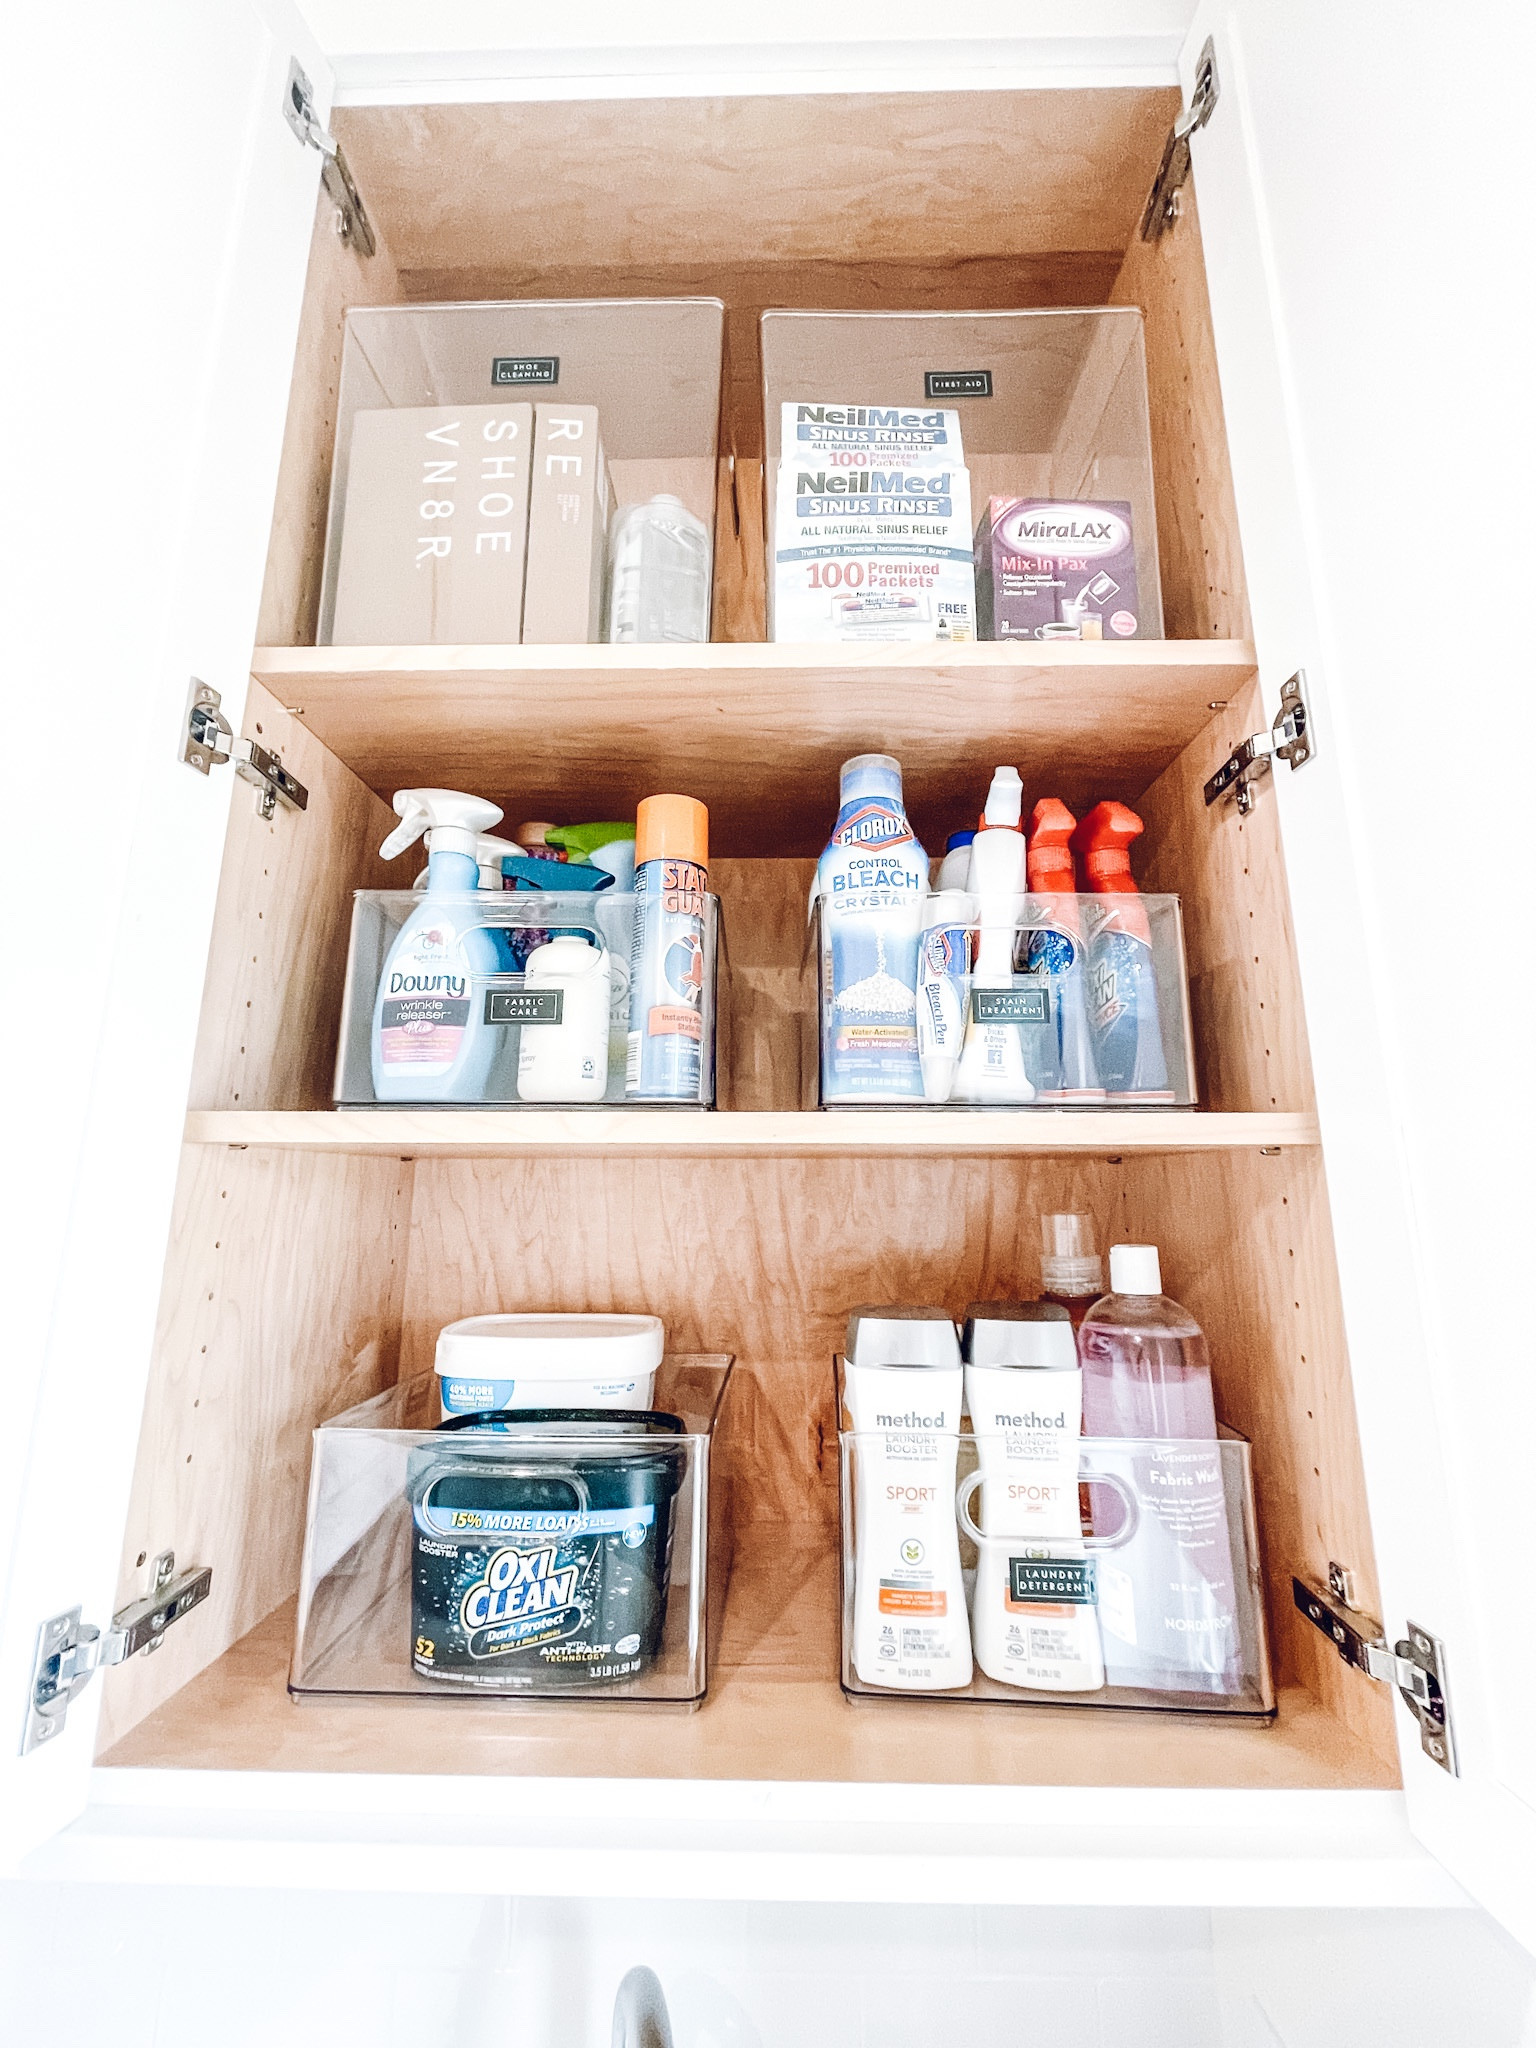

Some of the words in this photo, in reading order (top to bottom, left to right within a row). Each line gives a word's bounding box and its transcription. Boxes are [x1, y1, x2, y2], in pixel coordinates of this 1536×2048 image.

[500, 370, 550, 378] CLEANING
[964, 380, 982, 388] AID
[797, 405, 945, 428] NeilMed
[808, 426, 869, 442] SINUS
[874, 429, 935, 444] RINSE
[545, 418, 585, 477] RE
[811, 442, 829, 450] ALL
[830, 443, 870, 451] NATURAL
[874, 443, 901, 451] SINUS
[903, 444, 934, 452] RELIEF
[829, 451, 867, 467] 100
[869, 459, 912, 467] Packets
[475, 419, 519, 555] SHOE
[796, 471, 951, 495] NeilMed
[808, 498, 871, 515] SINUS
[876, 497, 941, 515] RINSE
[801, 525, 821, 536] ALL
[824, 524, 873, 535] NATURAL
[876, 524, 910, 535] SINUS
[912, 525, 948, 536] RELIEF
[1017, 521, 1112, 540] MiraLAX
[800, 549, 818, 557] Trust
[819, 547, 832, 555] The
[832, 545, 841, 553] #1
[843, 544, 876, 554] Physician
[877, 545, 927, 554] Recommended
[1001, 556, 1054, 571] Mix-In
[1058, 556, 1088, 571] Pax
[806, 561, 865, 589] 100
[868, 562, 940, 575] Premixed
[868, 574, 934, 588] Packets
[937, 602, 968, 615] FREE
[840, 816, 907, 847] CLOROX
[848, 858, 903, 870] CONTROL
[832, 870, 919, 893] BLEACH
[390, 973, 466, 998] Downy
[400, 1000, 444, 1010] wrinkle
[505, 998, 544, 1006] FABRIC
[928, 983, 945, 1022] Bleach
[995, 997, 1027, 1005] STAIN
[396, 1010, 447, 1020] releaser
[981, 1006, 1043, 1015] TREATMENT
[935, 1023, 948, 1045] Pen
[850, 1039, 870, 1047] Fresh
[871, 1040, 902, 1048] Meadow
[467, 1385, 494, 1396] MORE
[876, 1411, 945, 1428] method
[995, 1411, 1066, 1429] method
[885, 1434, 937, 1445] LAUNDRY
[885, 1444, 938, 1455] BOOSTER
[1006, 1445, 1059, 1455] BOOSTER
[1149, 1469, 1194, 1487] Fabric
[886, 1486, 938, 1502] SPORT
[1008, 1485, 1060, 1501] SPORT
[450, 1511, 483, 1529] 15%
[484, 1514, 532, 1531] MORE
[419, 1537, 459, 1551] LAUNDRY
[418, 1545, 459, 1559] BOOSTER
[489, 1549, 553, 1592] OXI
[1025, 1569, 1082, 1580] LAUNDRY
[1020, 1581, 1089, 1592] DETERGENT
[464, 1572, 574, 1628] CLEAN
[486, 1626, 517, 1643] Dark
[519, 1613, 565, 1635] Protect
[882, 1626, 893, 1635] 26
[1009, 1624, 1021, 1634] 26
[415, 1637, 436, 1658] 52
[539, 1644, 611, 1656] ANTI-FADE
[565, 1640, 587, 1648] WITH
[545, 1652, 606, 1663] TECHNOLOGY
[590, 1665, 602, 1678] 3.5
[602, 1665, 612, 1677] LB
